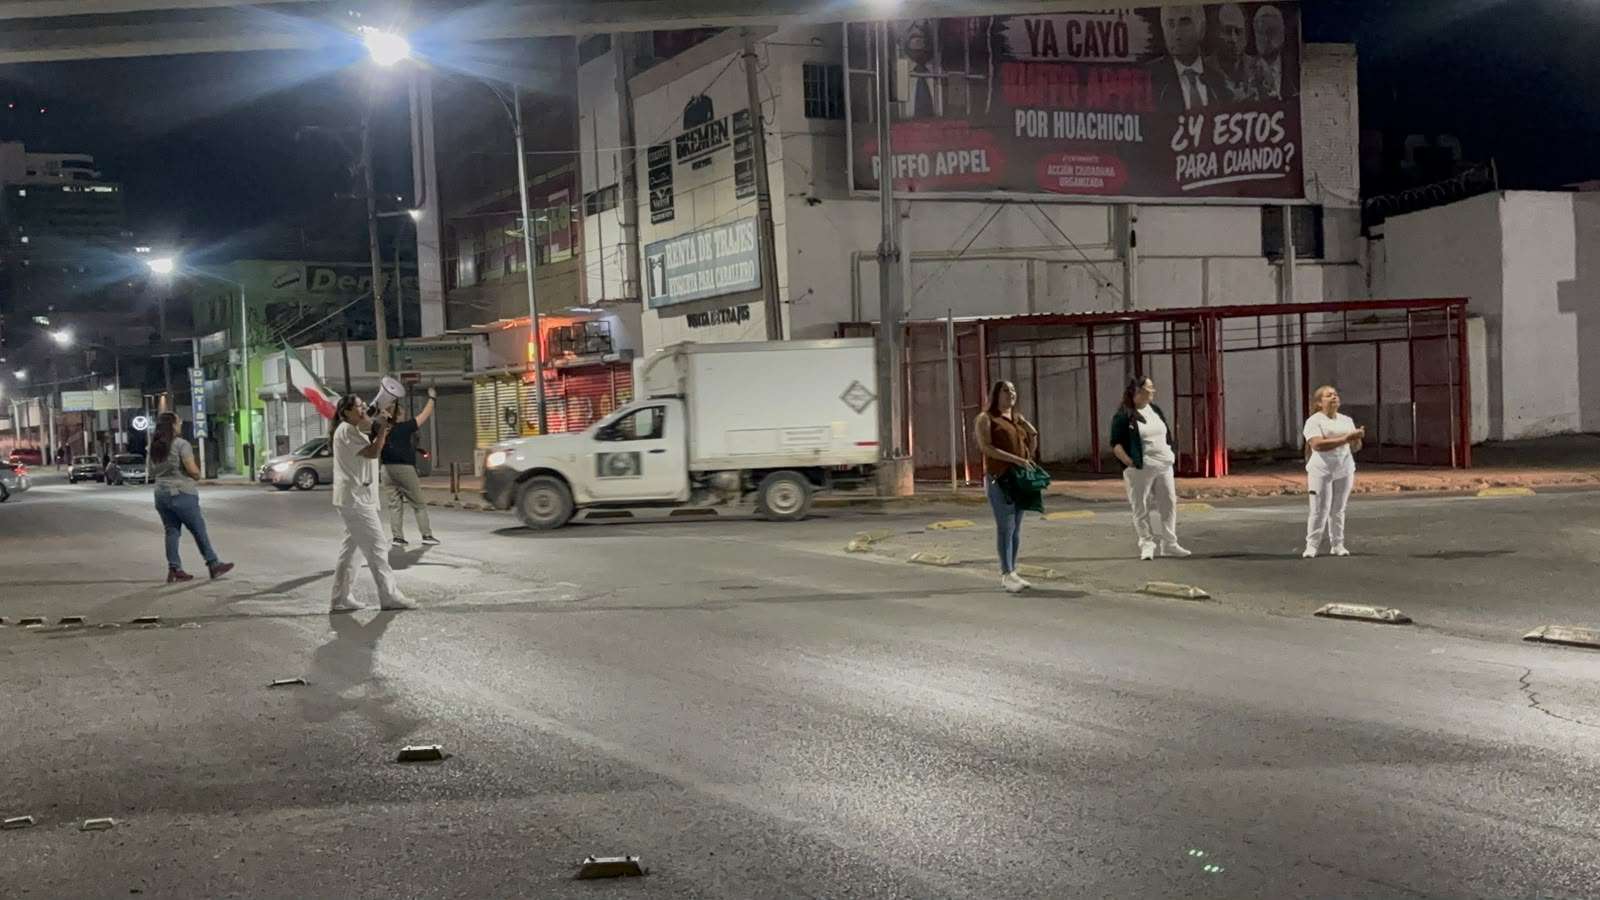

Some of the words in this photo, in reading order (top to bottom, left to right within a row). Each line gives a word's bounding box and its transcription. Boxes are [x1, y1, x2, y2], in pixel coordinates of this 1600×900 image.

[1024, 19, 1058, 57] YA
[1015, 109, 1048, 138] POR
[1053, 111, 1143, 142] HUACHICOL
[1170, 113, 1204, 152] ¿Y
[1212, 110, 1286, 145] ESTOS
[935, 149, 991, 176] APPEL
[1176, 151, 1218, 182] PARA
[1223, 142, 1295, 175] CUANDO?
